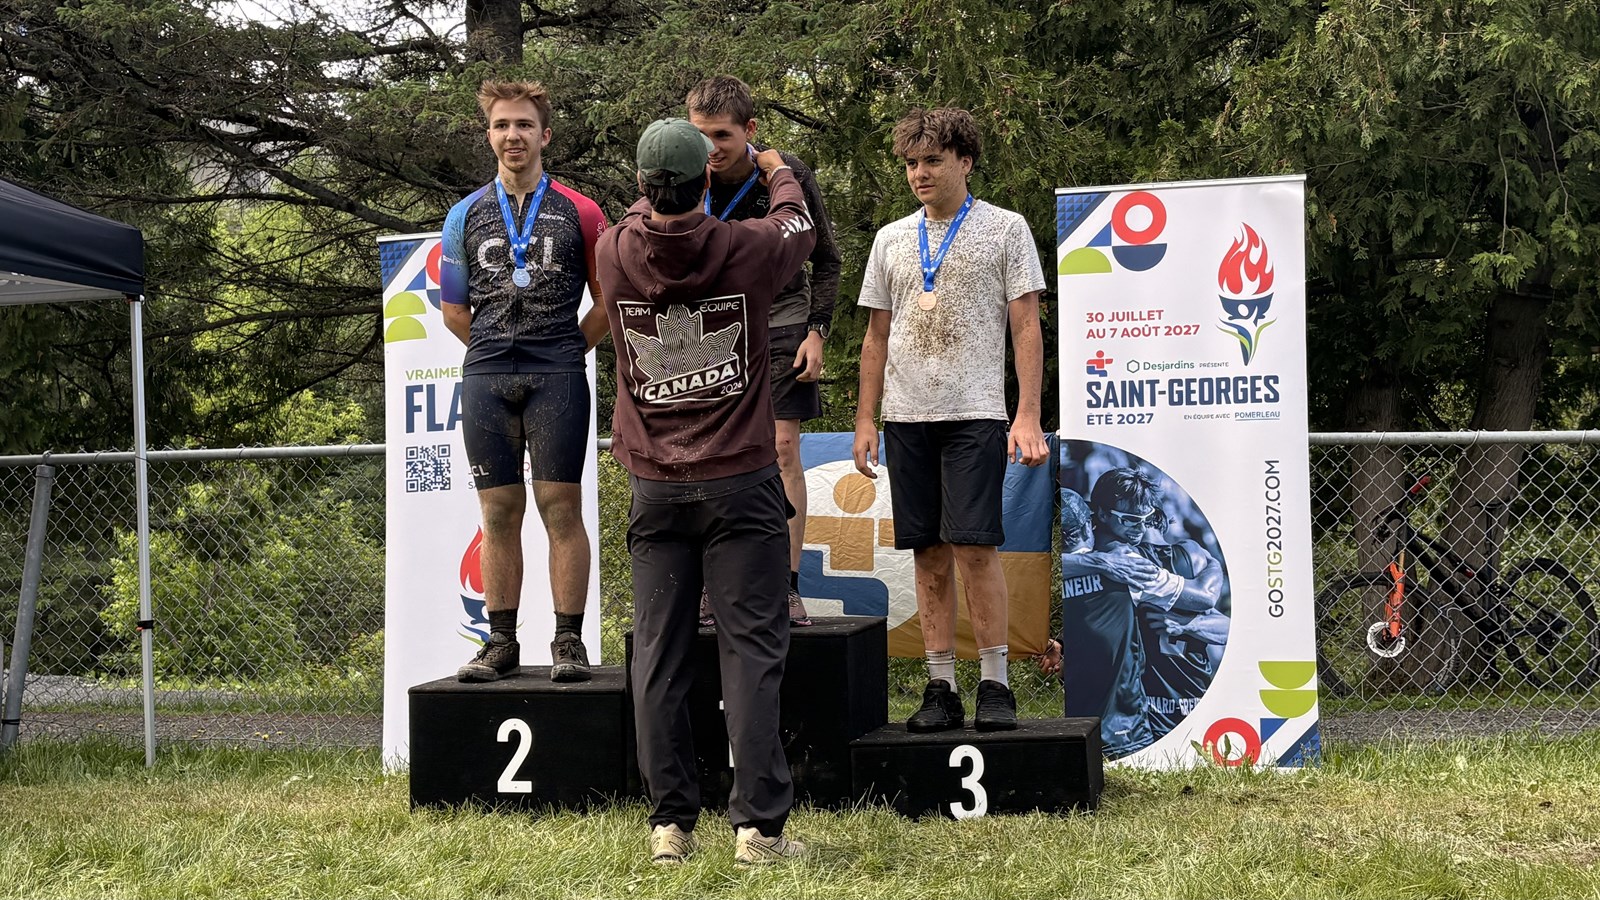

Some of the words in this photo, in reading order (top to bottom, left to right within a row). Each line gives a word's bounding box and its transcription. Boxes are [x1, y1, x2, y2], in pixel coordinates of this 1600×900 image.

[624, 307, 651, 317] TEAM
[700, 301, 740, 313] ÉQUIPE
[1086, 312, 1104, 323] 30
[1108, 310, 1164, 322] JUILLET
[1086, 328, 1106, 339] AU
[1109, 328, 1117, 338] 7
[1120, 324, 1161, 338] AOÛT
[1164, 325, 1200, 336] 2027
[405, 367, 463, 380] VRAIME
[1143, 361, 1195, 372] Desjardins
[644, 363, 736, 401] CANADA
[720, 381, 743, 395] 2026
[1086, 375, 1280, 409] SAINT-GEORGES
[1086, 412, 1113, 425] ÉTÉ
[1117, 413, 1154, 425] 2027
[1265, 460, 1284, 618] GOSTG2027.COM
[496, 718, 533, 793] 2
[948, 745, 988, 819] 3
